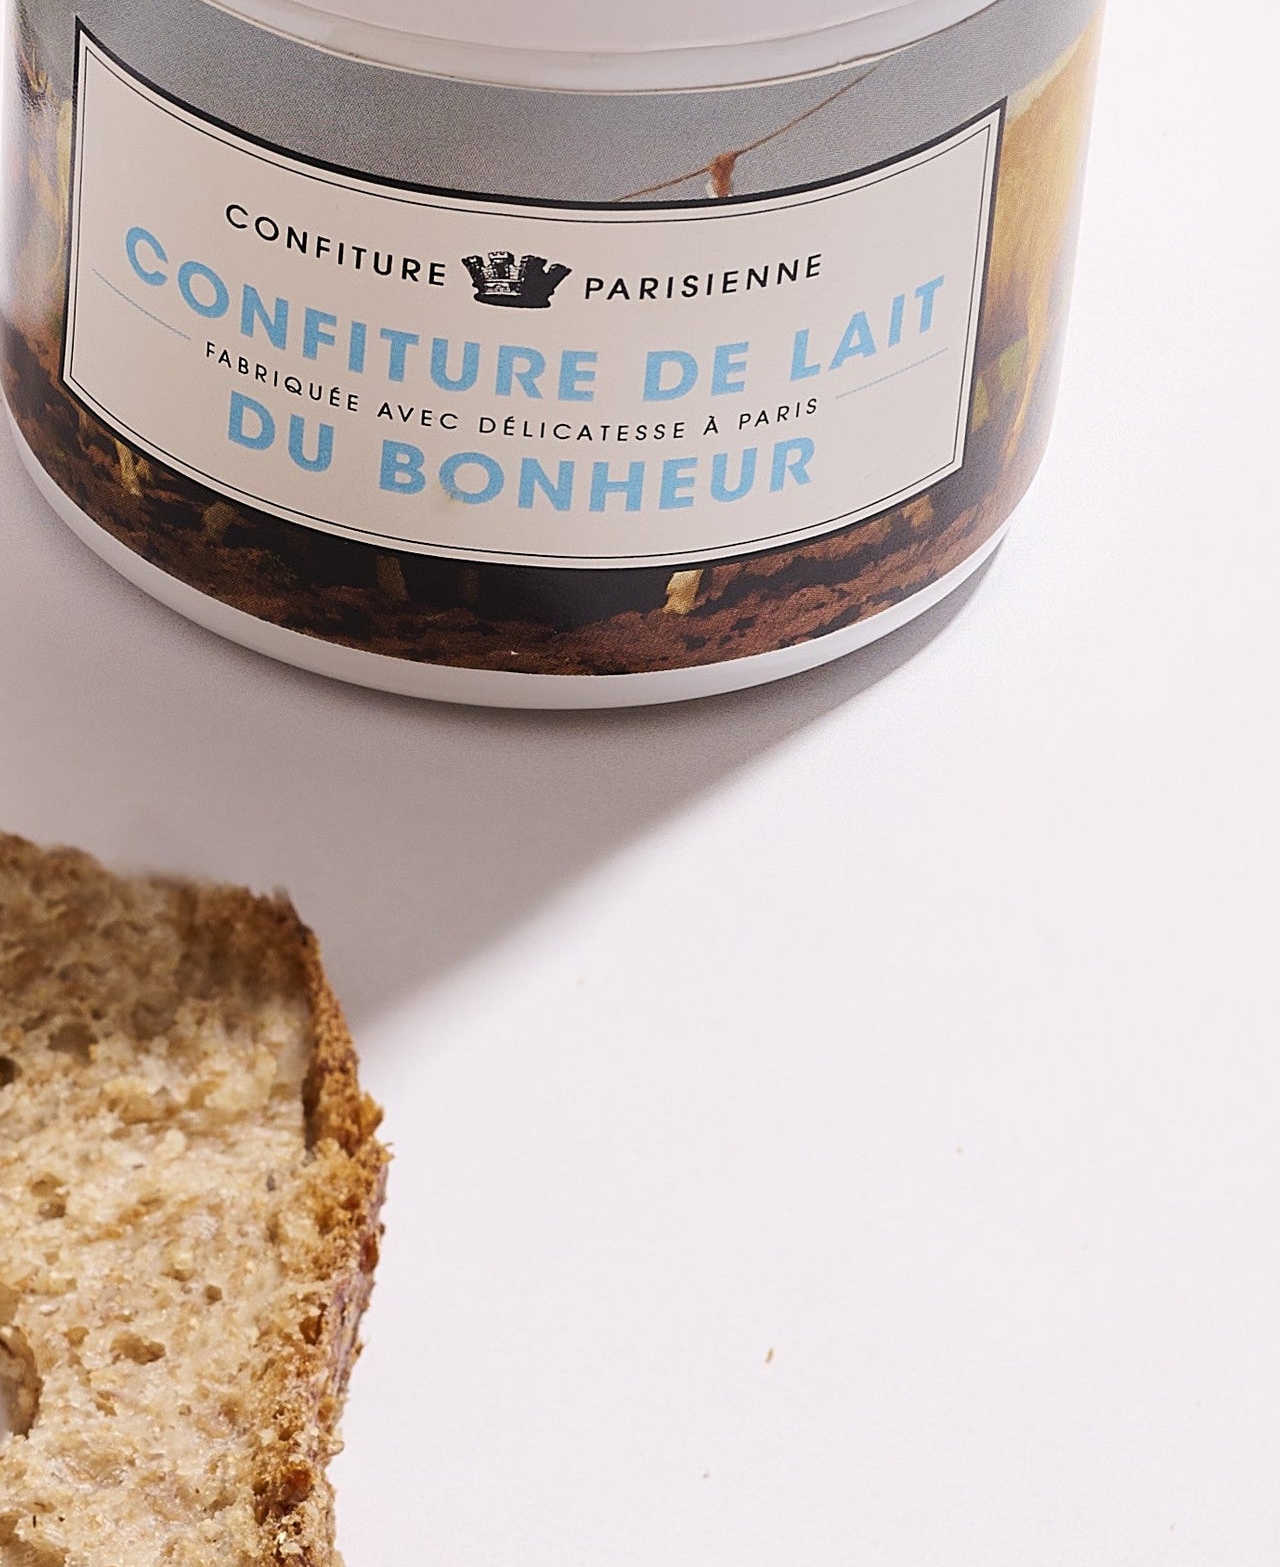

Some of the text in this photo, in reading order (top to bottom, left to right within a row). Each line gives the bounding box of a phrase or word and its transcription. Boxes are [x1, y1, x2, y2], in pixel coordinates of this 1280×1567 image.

[225, 203, 822, 301] CONFITURE PARISIENNE
[125, 227, 944, 402] CONFITURE DE LAIT
[205, 340, 818, 442] FABRIQUÉE AVEC DÉLICATESSE À PARIS
[228, 392, 816, 512] DU BONHEUR
